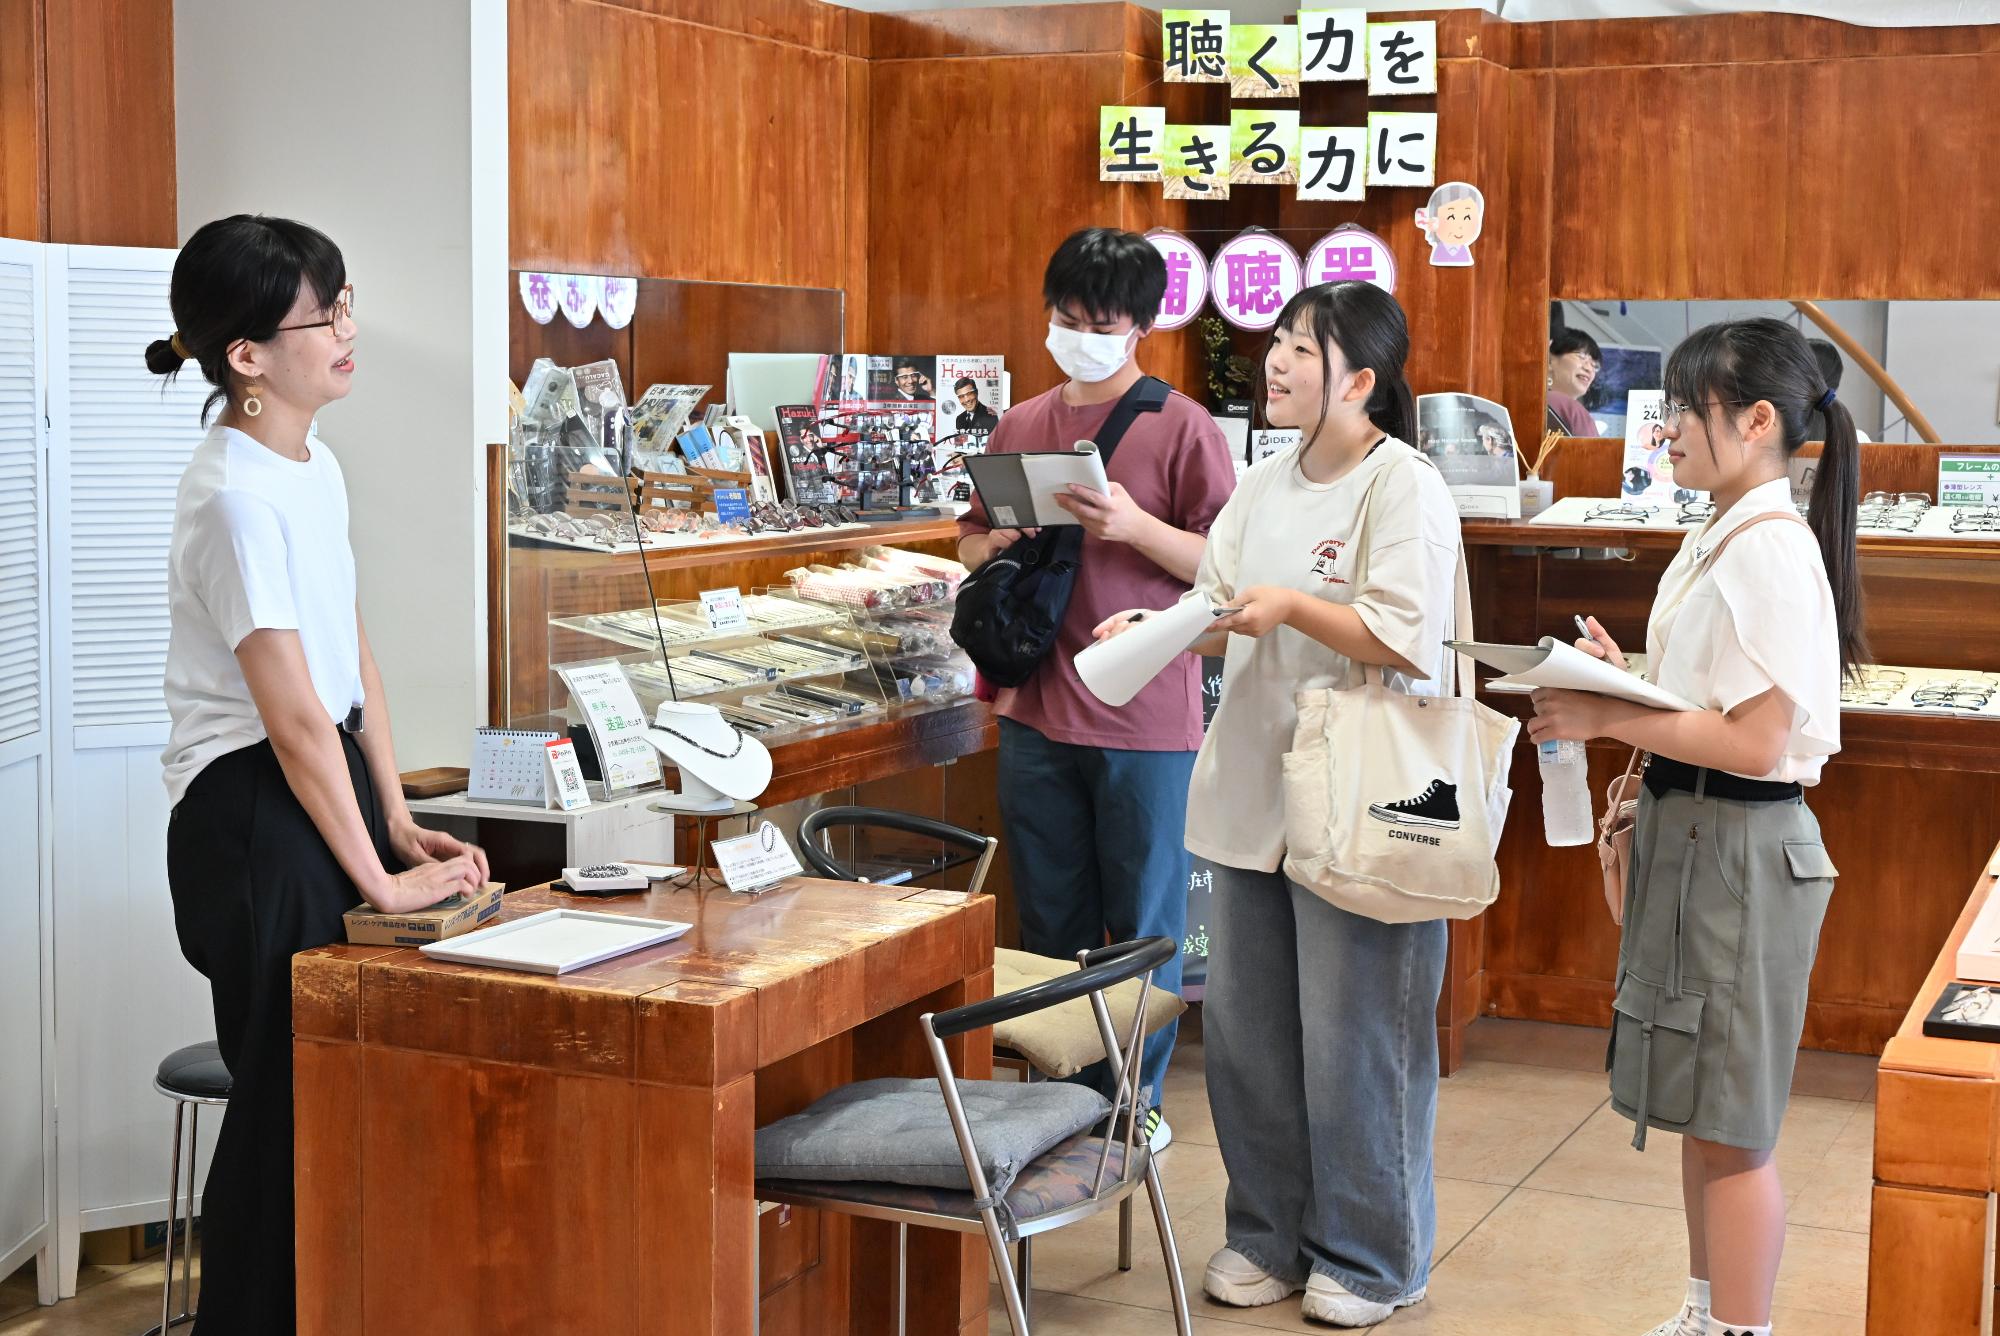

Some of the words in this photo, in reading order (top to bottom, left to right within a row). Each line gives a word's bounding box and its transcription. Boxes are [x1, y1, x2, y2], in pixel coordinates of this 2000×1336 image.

[1165, 17, 1425, 90] 聴く力を
[1106, 116, 1425, 192] 生きる力に
[941, 363, 999, 379] Hazuki
[781, 407, 817, 418] Hazuki
[1258, 435, 1294, 446] WIDEX
[1956, 462, 2000, 471] フレームの
[1388, 829, 1441, 847] CONVERSE
